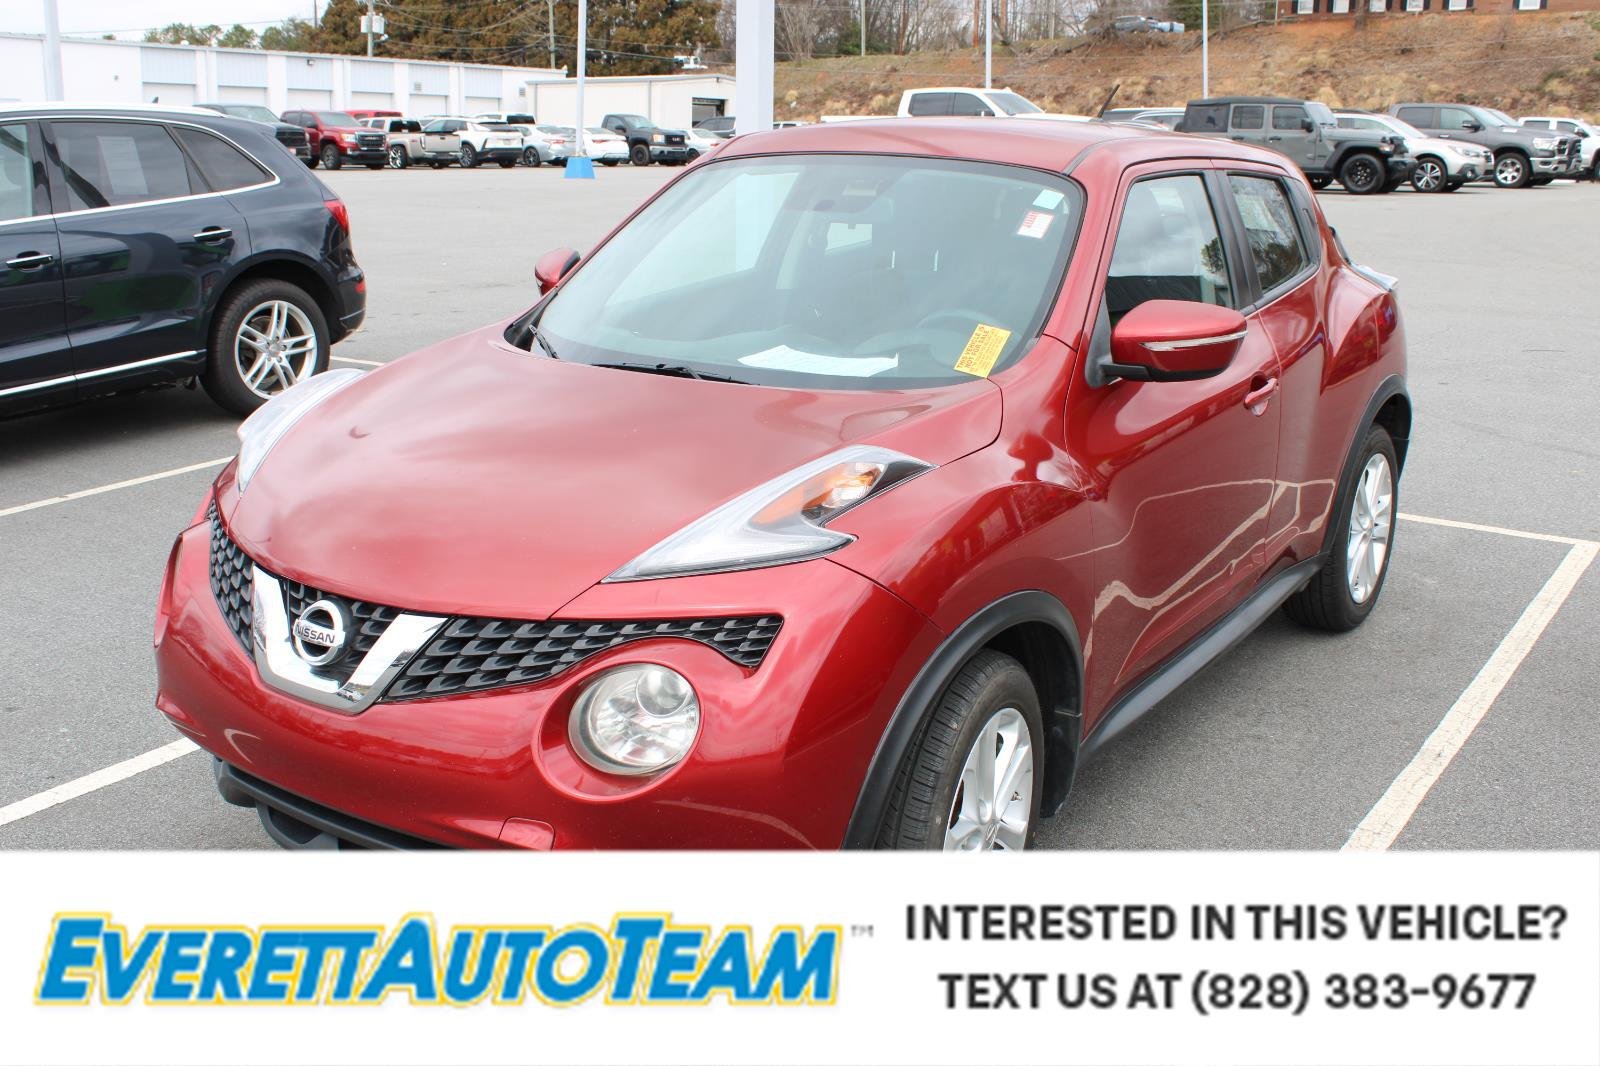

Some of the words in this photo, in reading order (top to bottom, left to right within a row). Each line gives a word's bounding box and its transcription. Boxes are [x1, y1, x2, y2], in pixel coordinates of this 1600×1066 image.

[964, 332, 981, 355] VEHICLE
[965, 356, 975, 369] NOT
[296, 624, 335, 644] NISSAN
